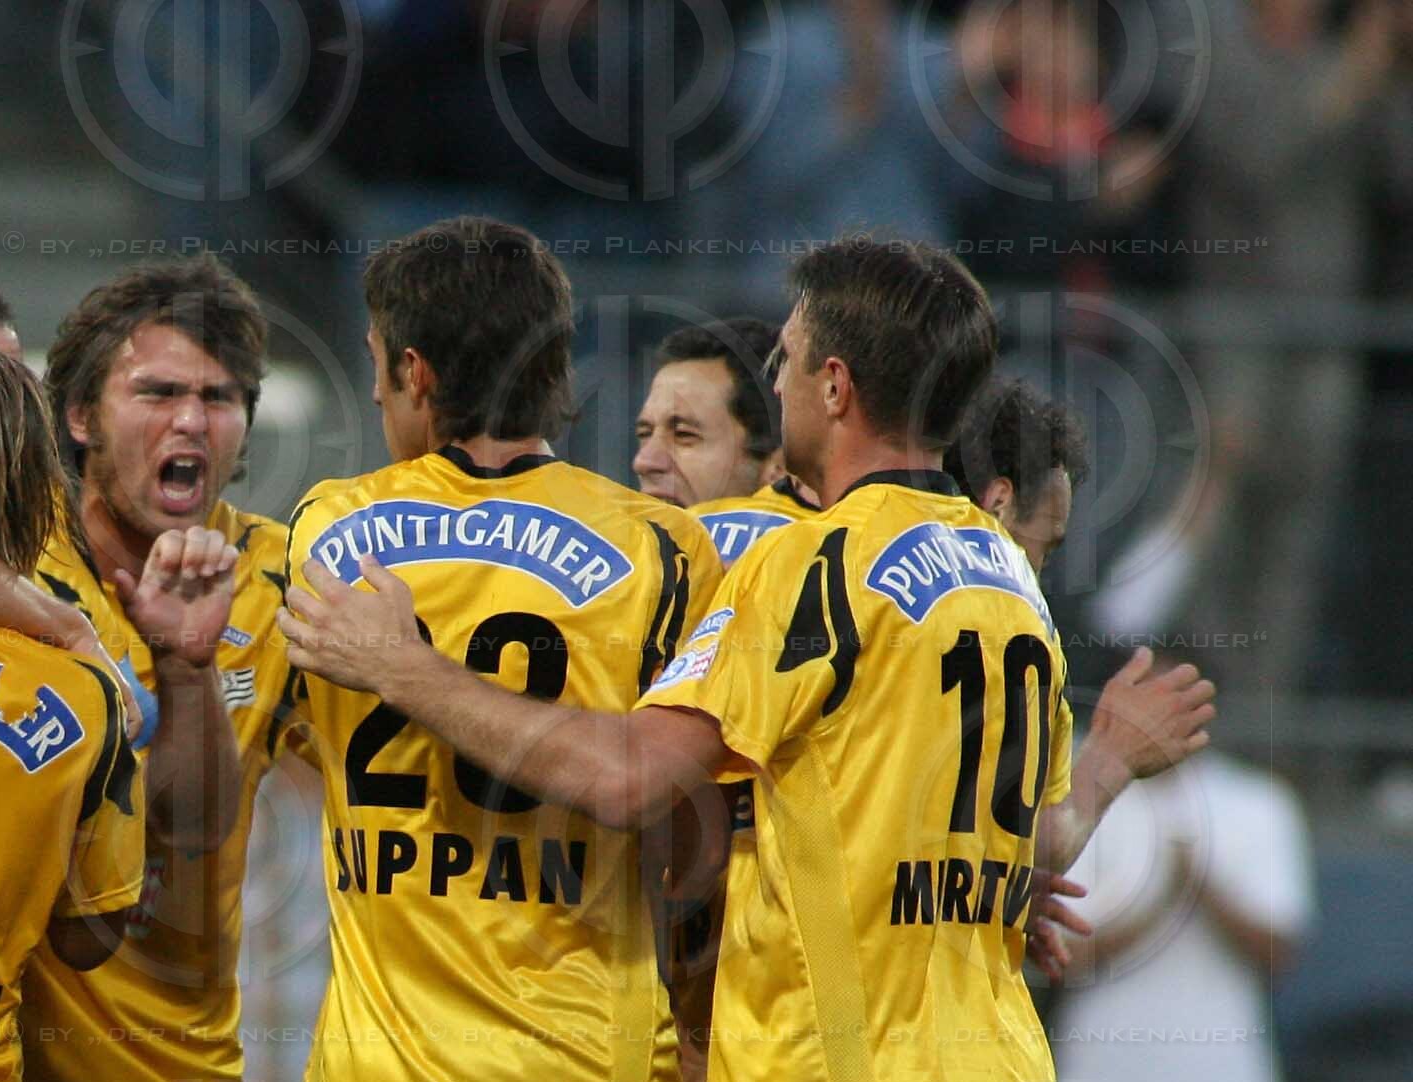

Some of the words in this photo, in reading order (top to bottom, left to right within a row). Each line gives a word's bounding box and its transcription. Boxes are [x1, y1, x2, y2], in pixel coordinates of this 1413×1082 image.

[318, 509, 612, 597] PUNTIGAMER
[940, 628, 1052, 838] 10
[334, 827, 587, 905] SUPPAN
